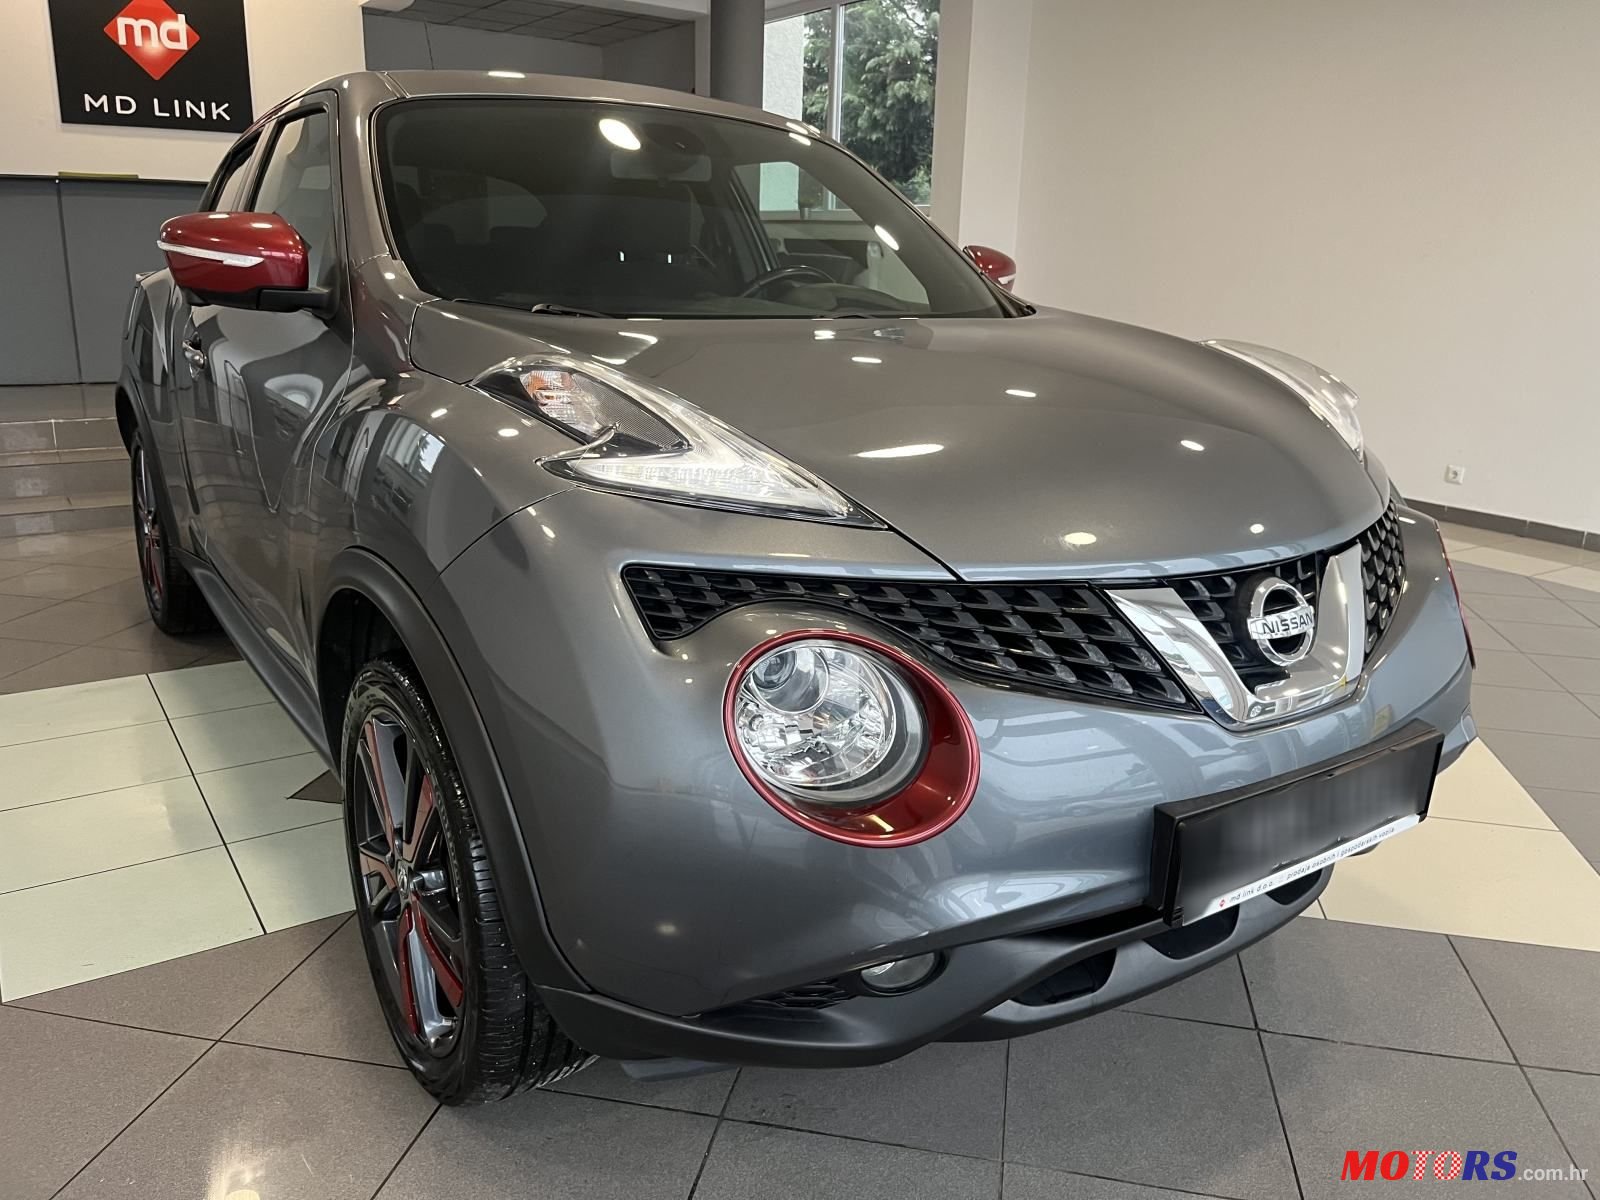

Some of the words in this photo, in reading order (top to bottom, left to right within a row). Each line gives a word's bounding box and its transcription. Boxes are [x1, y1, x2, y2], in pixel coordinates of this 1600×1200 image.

[116, 13, 188, 50] md
[84, 93, 137, 115] MD
[153, 98, 231, 121] LINK
[1262, 612, 1313, 634] NISSAN
[1286, 865, 1311, 880] prodaja
